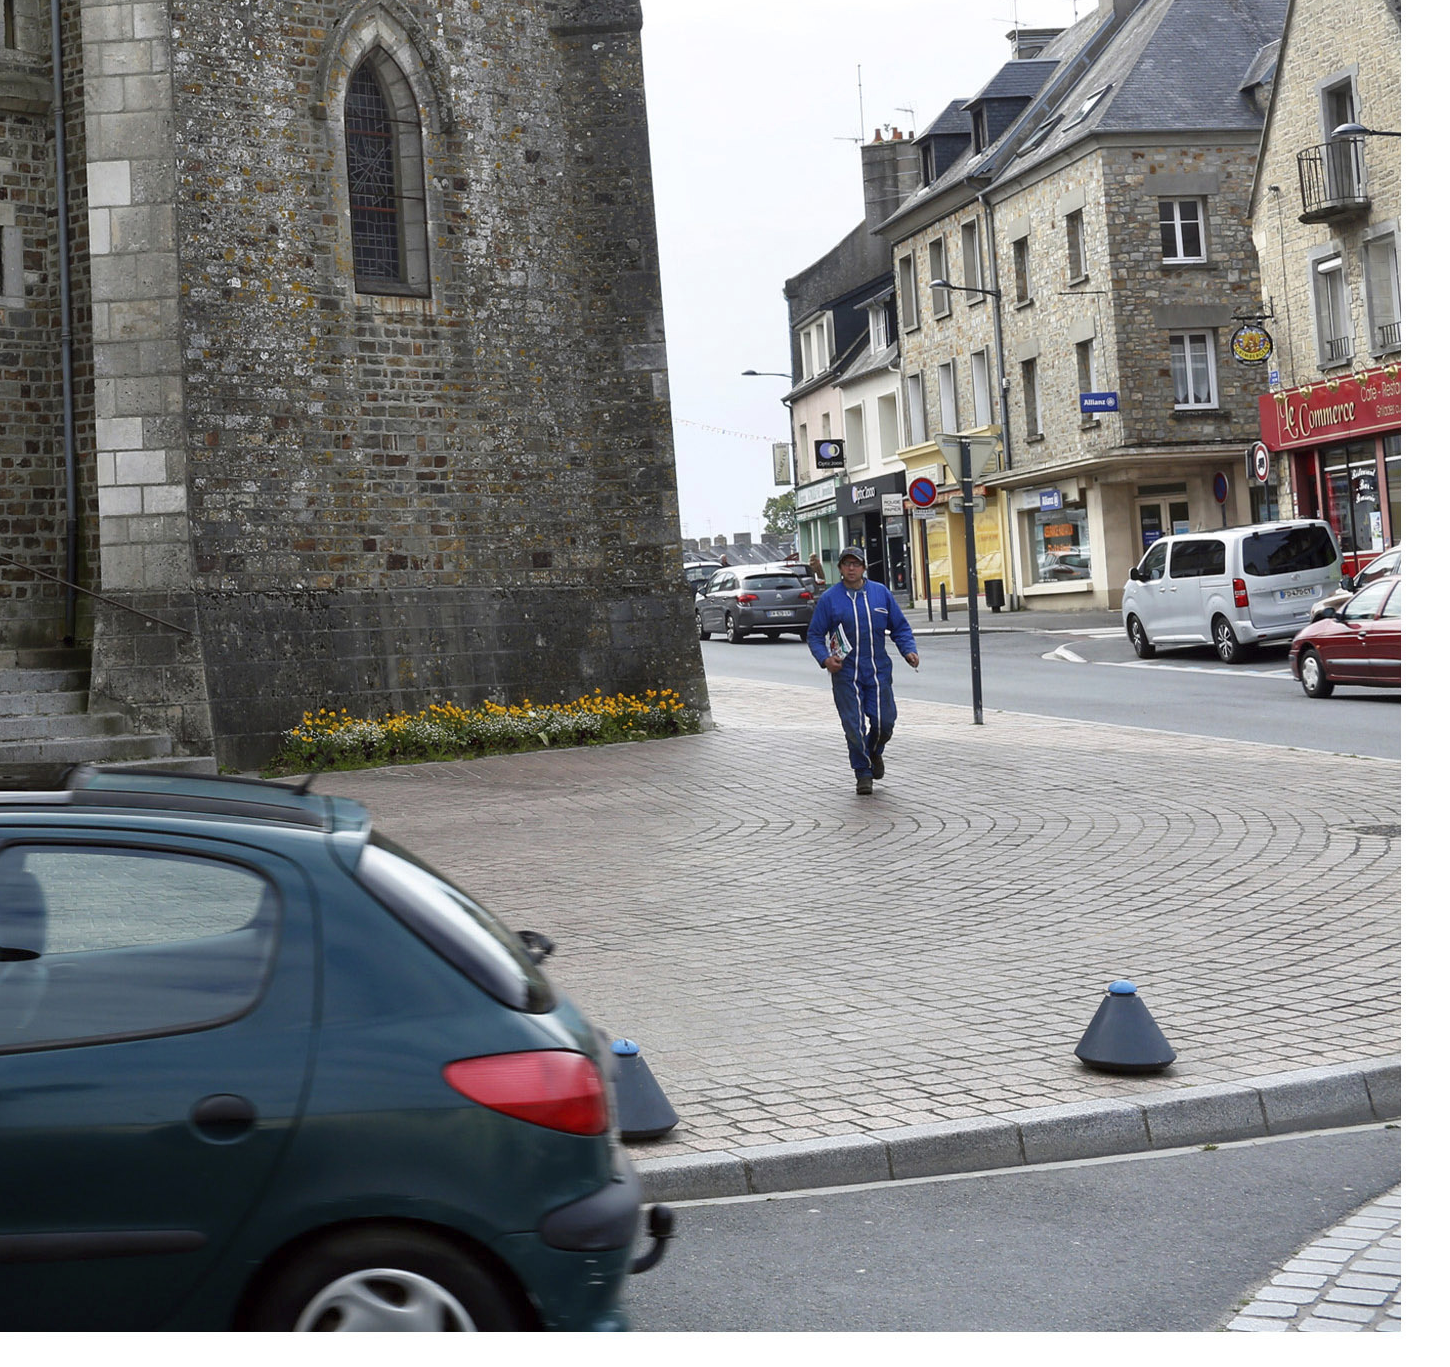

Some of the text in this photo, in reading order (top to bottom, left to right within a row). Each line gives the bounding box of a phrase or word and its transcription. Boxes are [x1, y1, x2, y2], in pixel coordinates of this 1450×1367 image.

[1083, 398, 1106, 406] Allianz
[1279, 397, 1356, 439] Le Commerce
